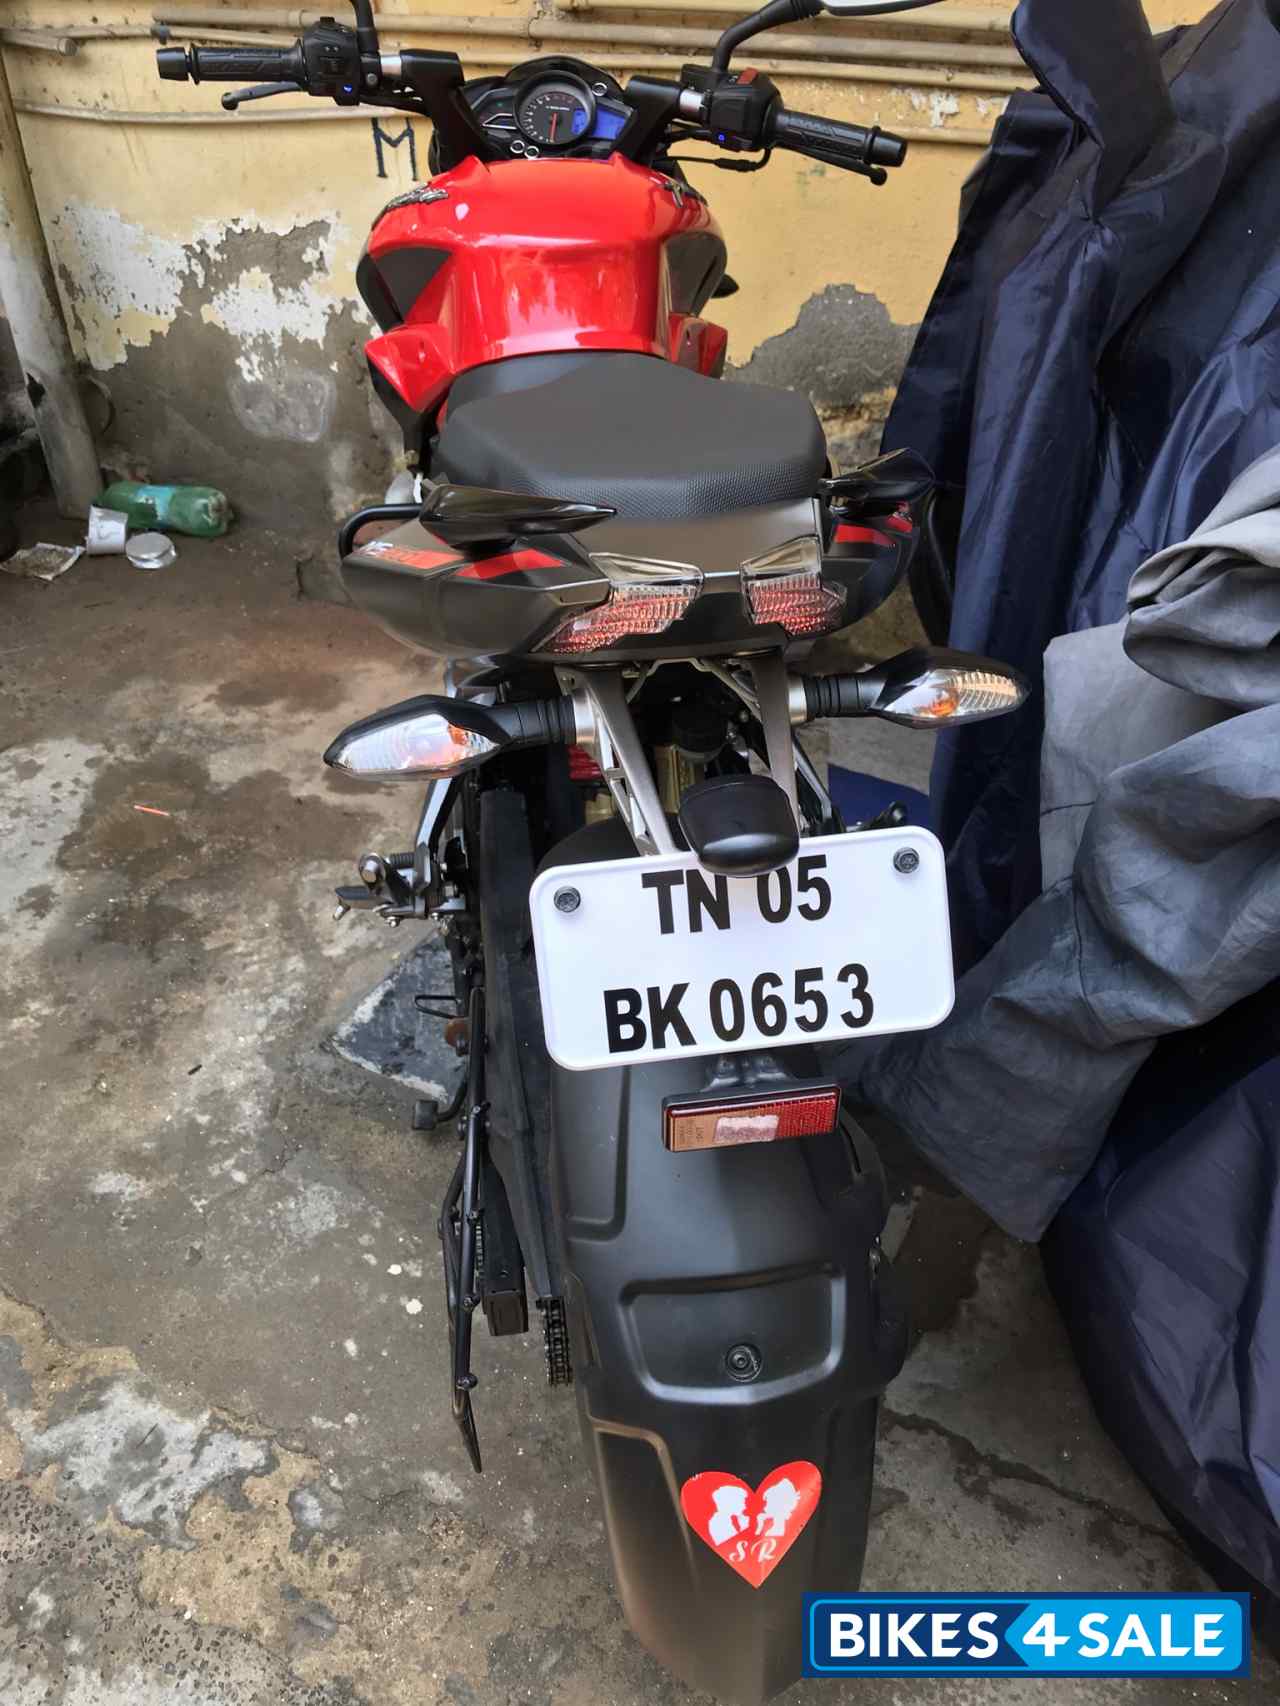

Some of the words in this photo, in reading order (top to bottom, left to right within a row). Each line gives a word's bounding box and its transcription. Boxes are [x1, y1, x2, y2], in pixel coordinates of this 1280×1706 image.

[641, 869, 731, 935] TN
[757, 854, 832, 924] 05
[603, 982, 697, 1054] BK
[709, 963, 874, 1042] 0653
